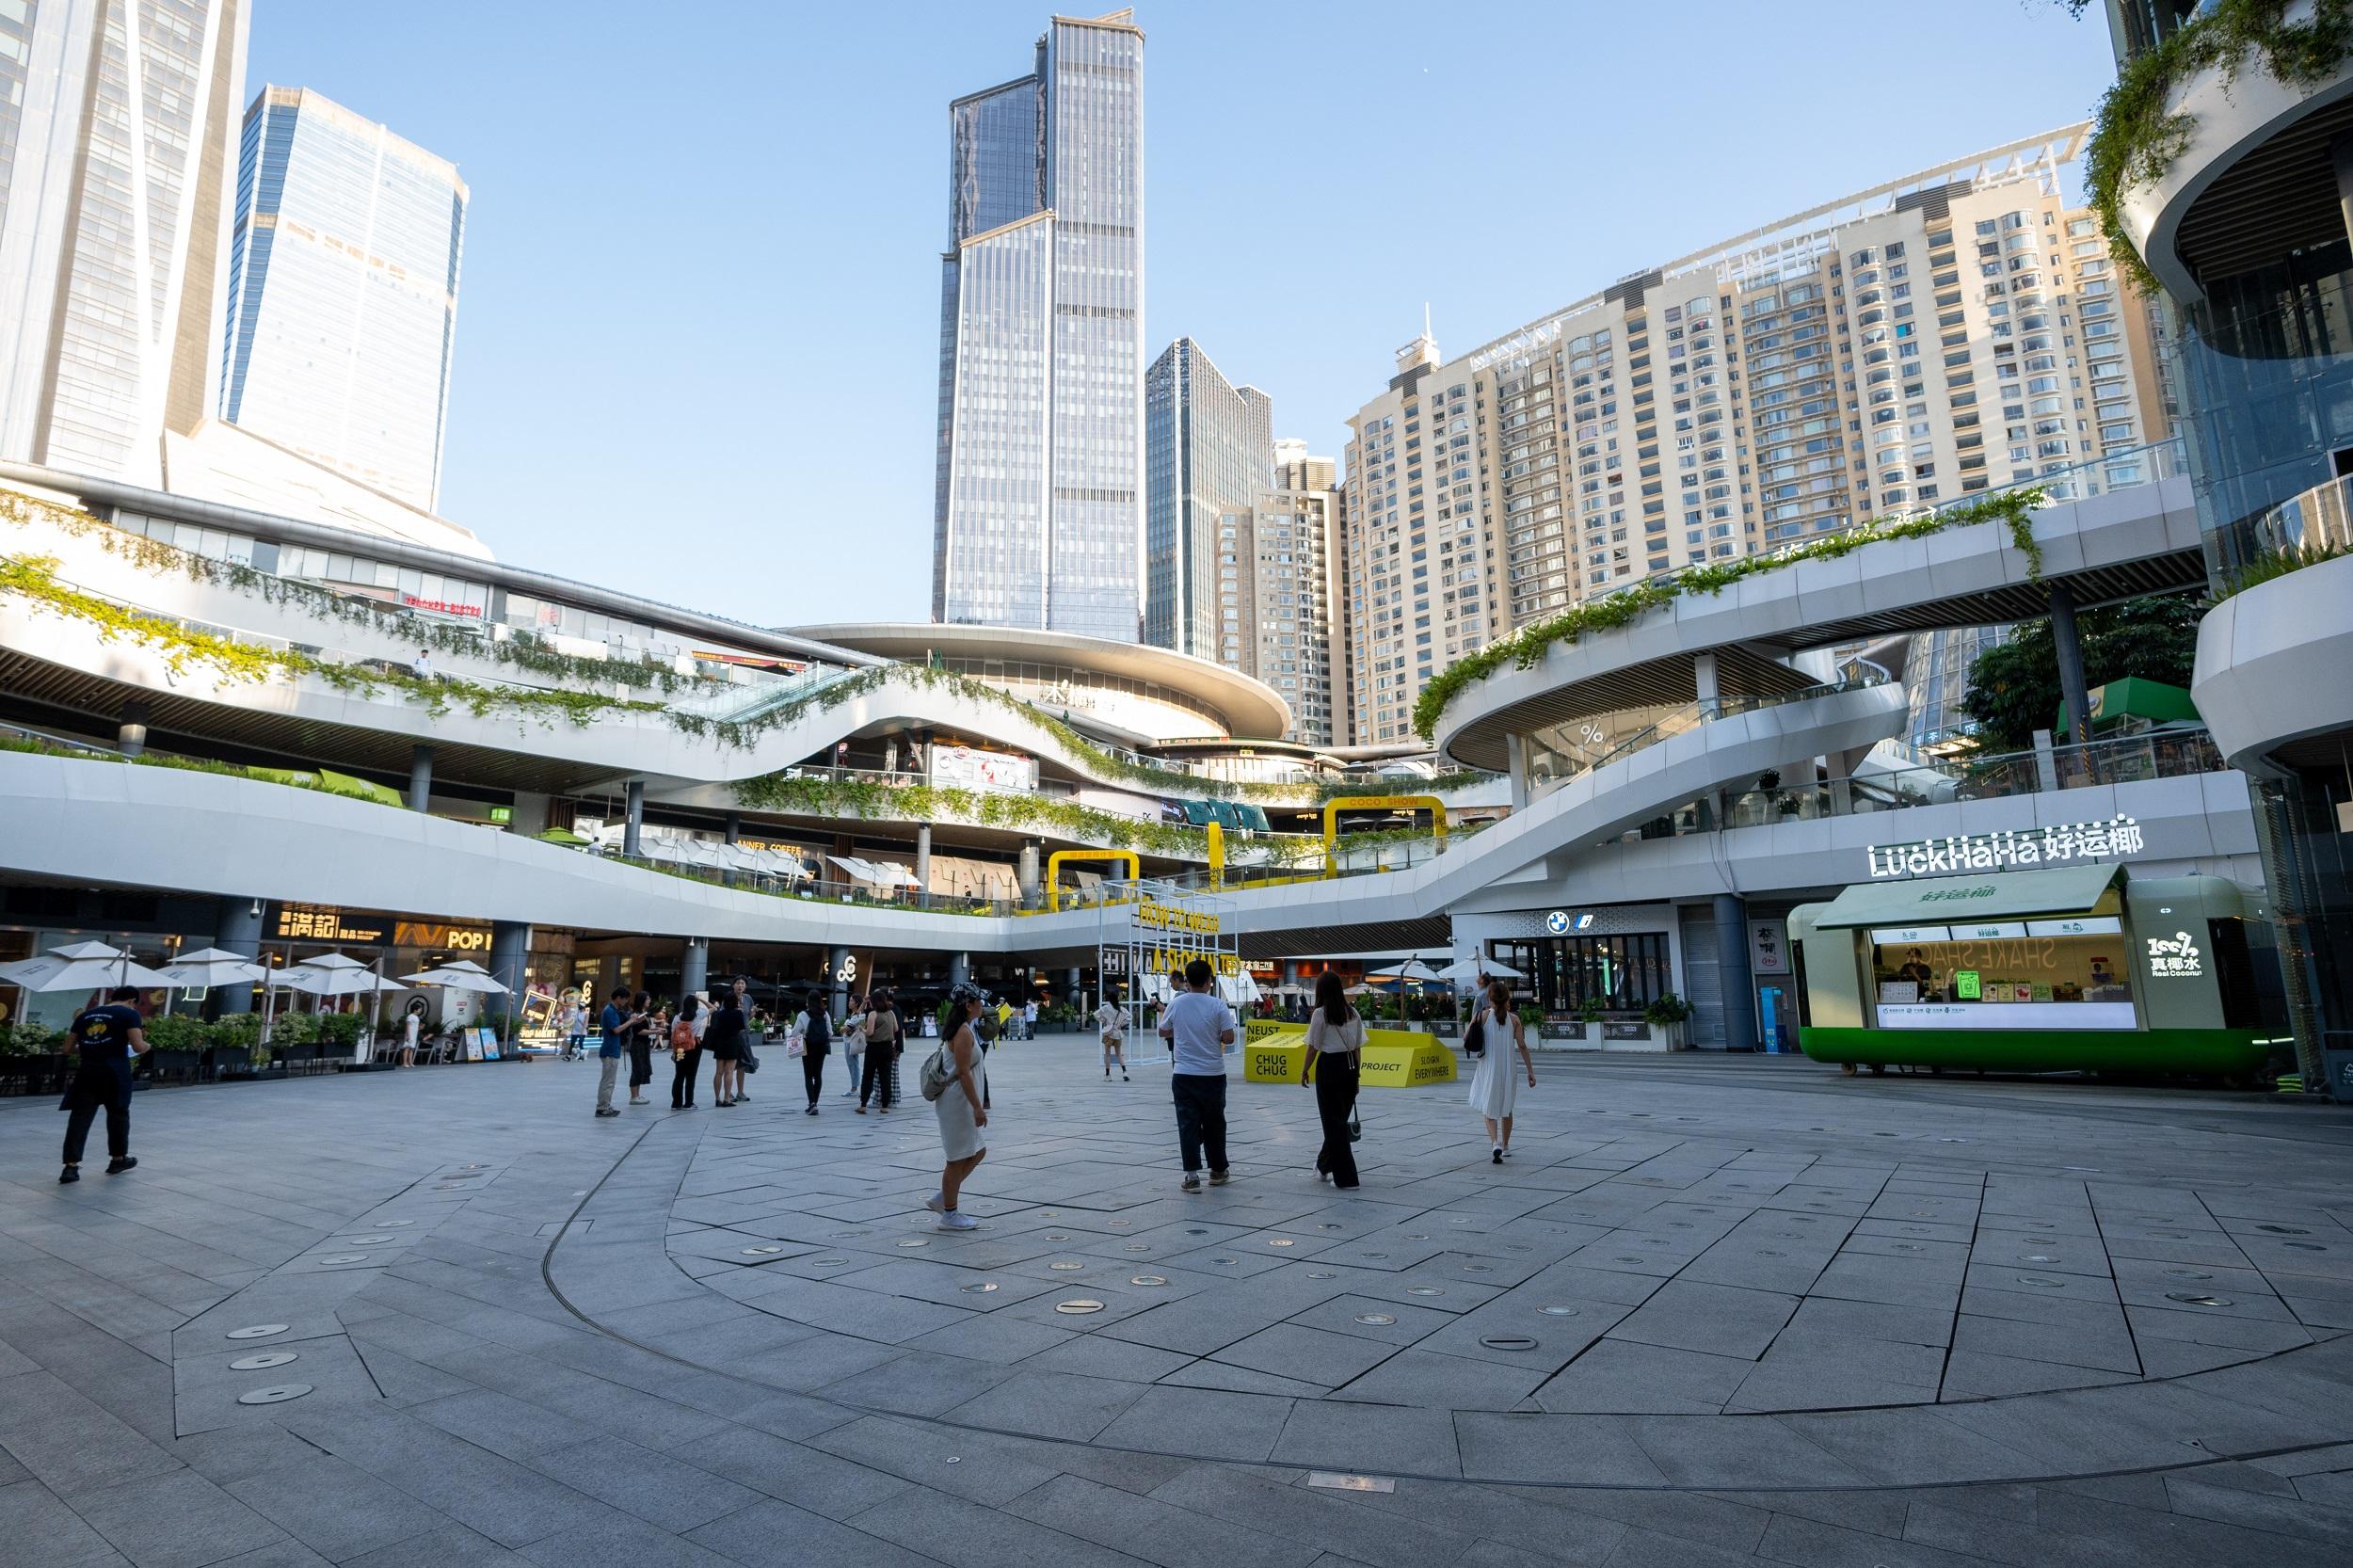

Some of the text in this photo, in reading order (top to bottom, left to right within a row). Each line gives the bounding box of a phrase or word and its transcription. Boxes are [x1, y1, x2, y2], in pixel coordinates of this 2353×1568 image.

[1350, 797, 1418, 807] COCO SHOW
[2043, 812, 2144, 860] 好运椰
[1918, 885, 1997, 903] 好运椰
[1139, 902, 1221, 934] HOW TO WEAR
[447, 931, 484, 950] POP
[1153, 948, 1163, 974] A
[2150, 957, 2201, 970] 真椰水
[1257, 1054, 1287, 1064] CHUG
[1420, 1055, 1439, 1064] SLOGAN
[1257, 1064, 1288, 1076] CHUG
[1361, 1062, 1401, 1072] PROJECT
